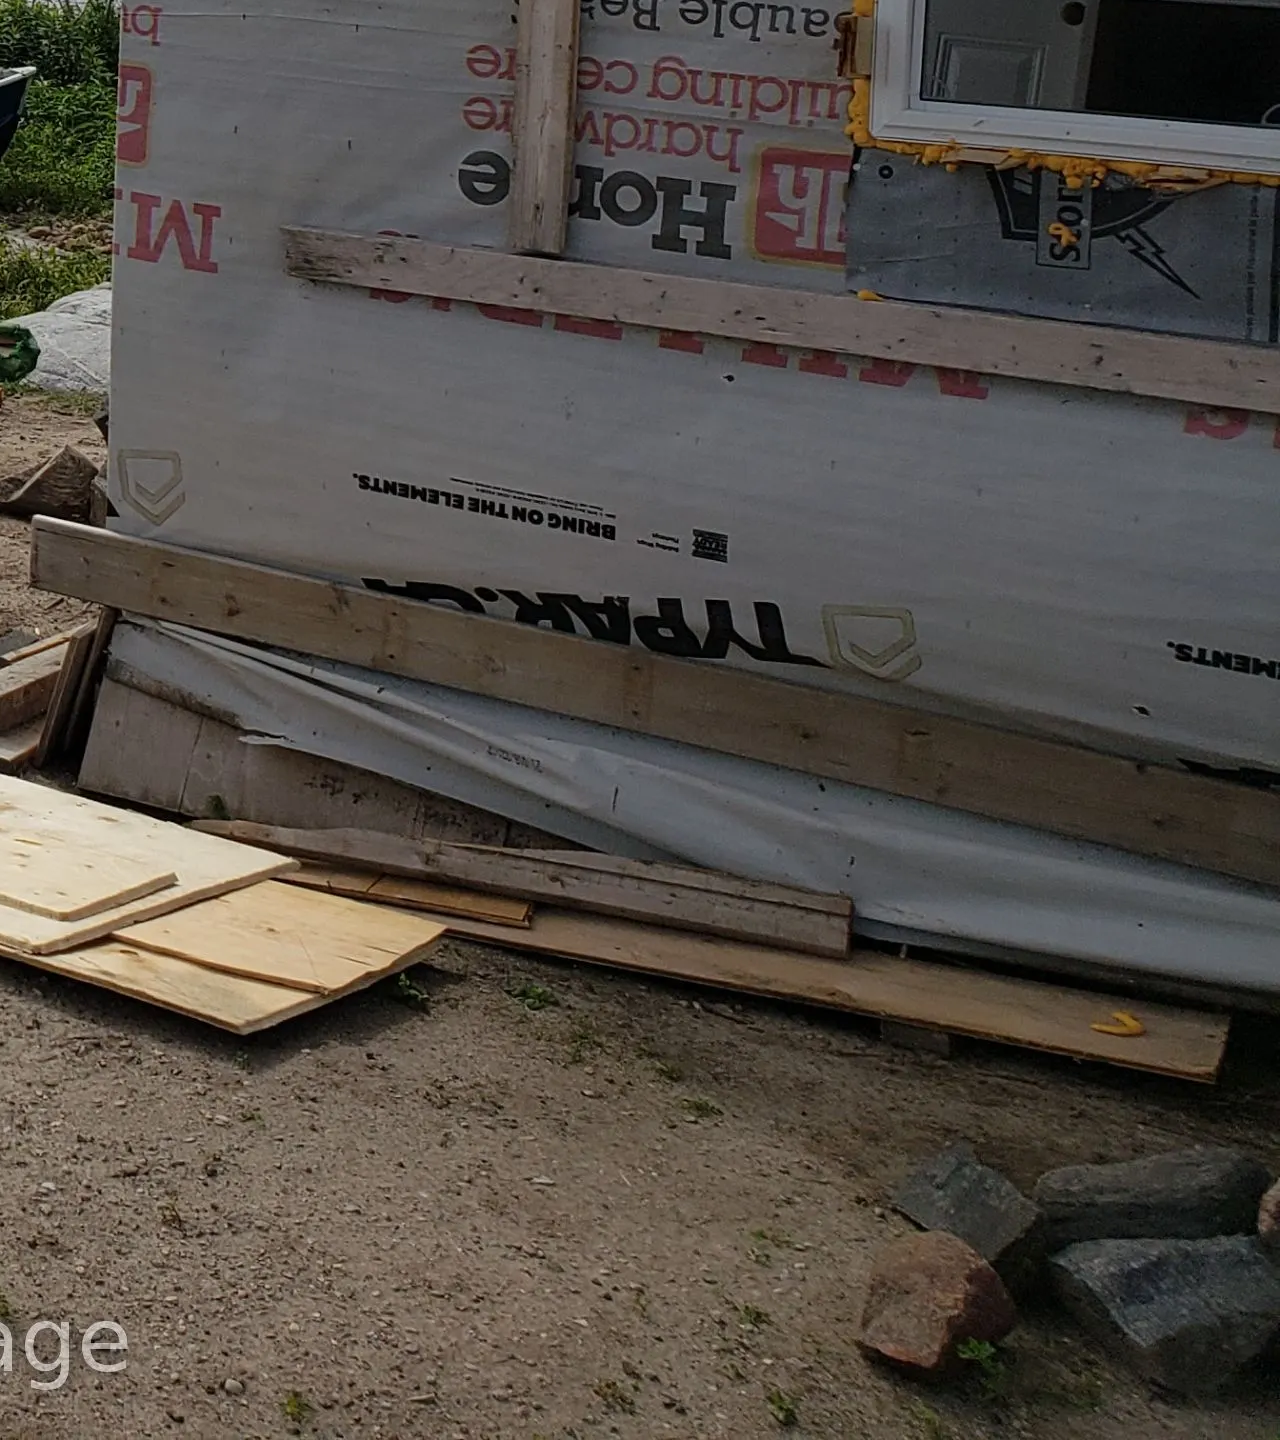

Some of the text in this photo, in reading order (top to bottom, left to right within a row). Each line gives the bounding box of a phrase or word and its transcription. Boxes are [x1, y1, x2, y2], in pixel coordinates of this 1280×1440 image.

[352, 472, 464, 510] ELEMENTS.
[467, 497, 508, 520] THE
[511, 505, 544, 526] ON
[547, 514, 616, 541] BRING
